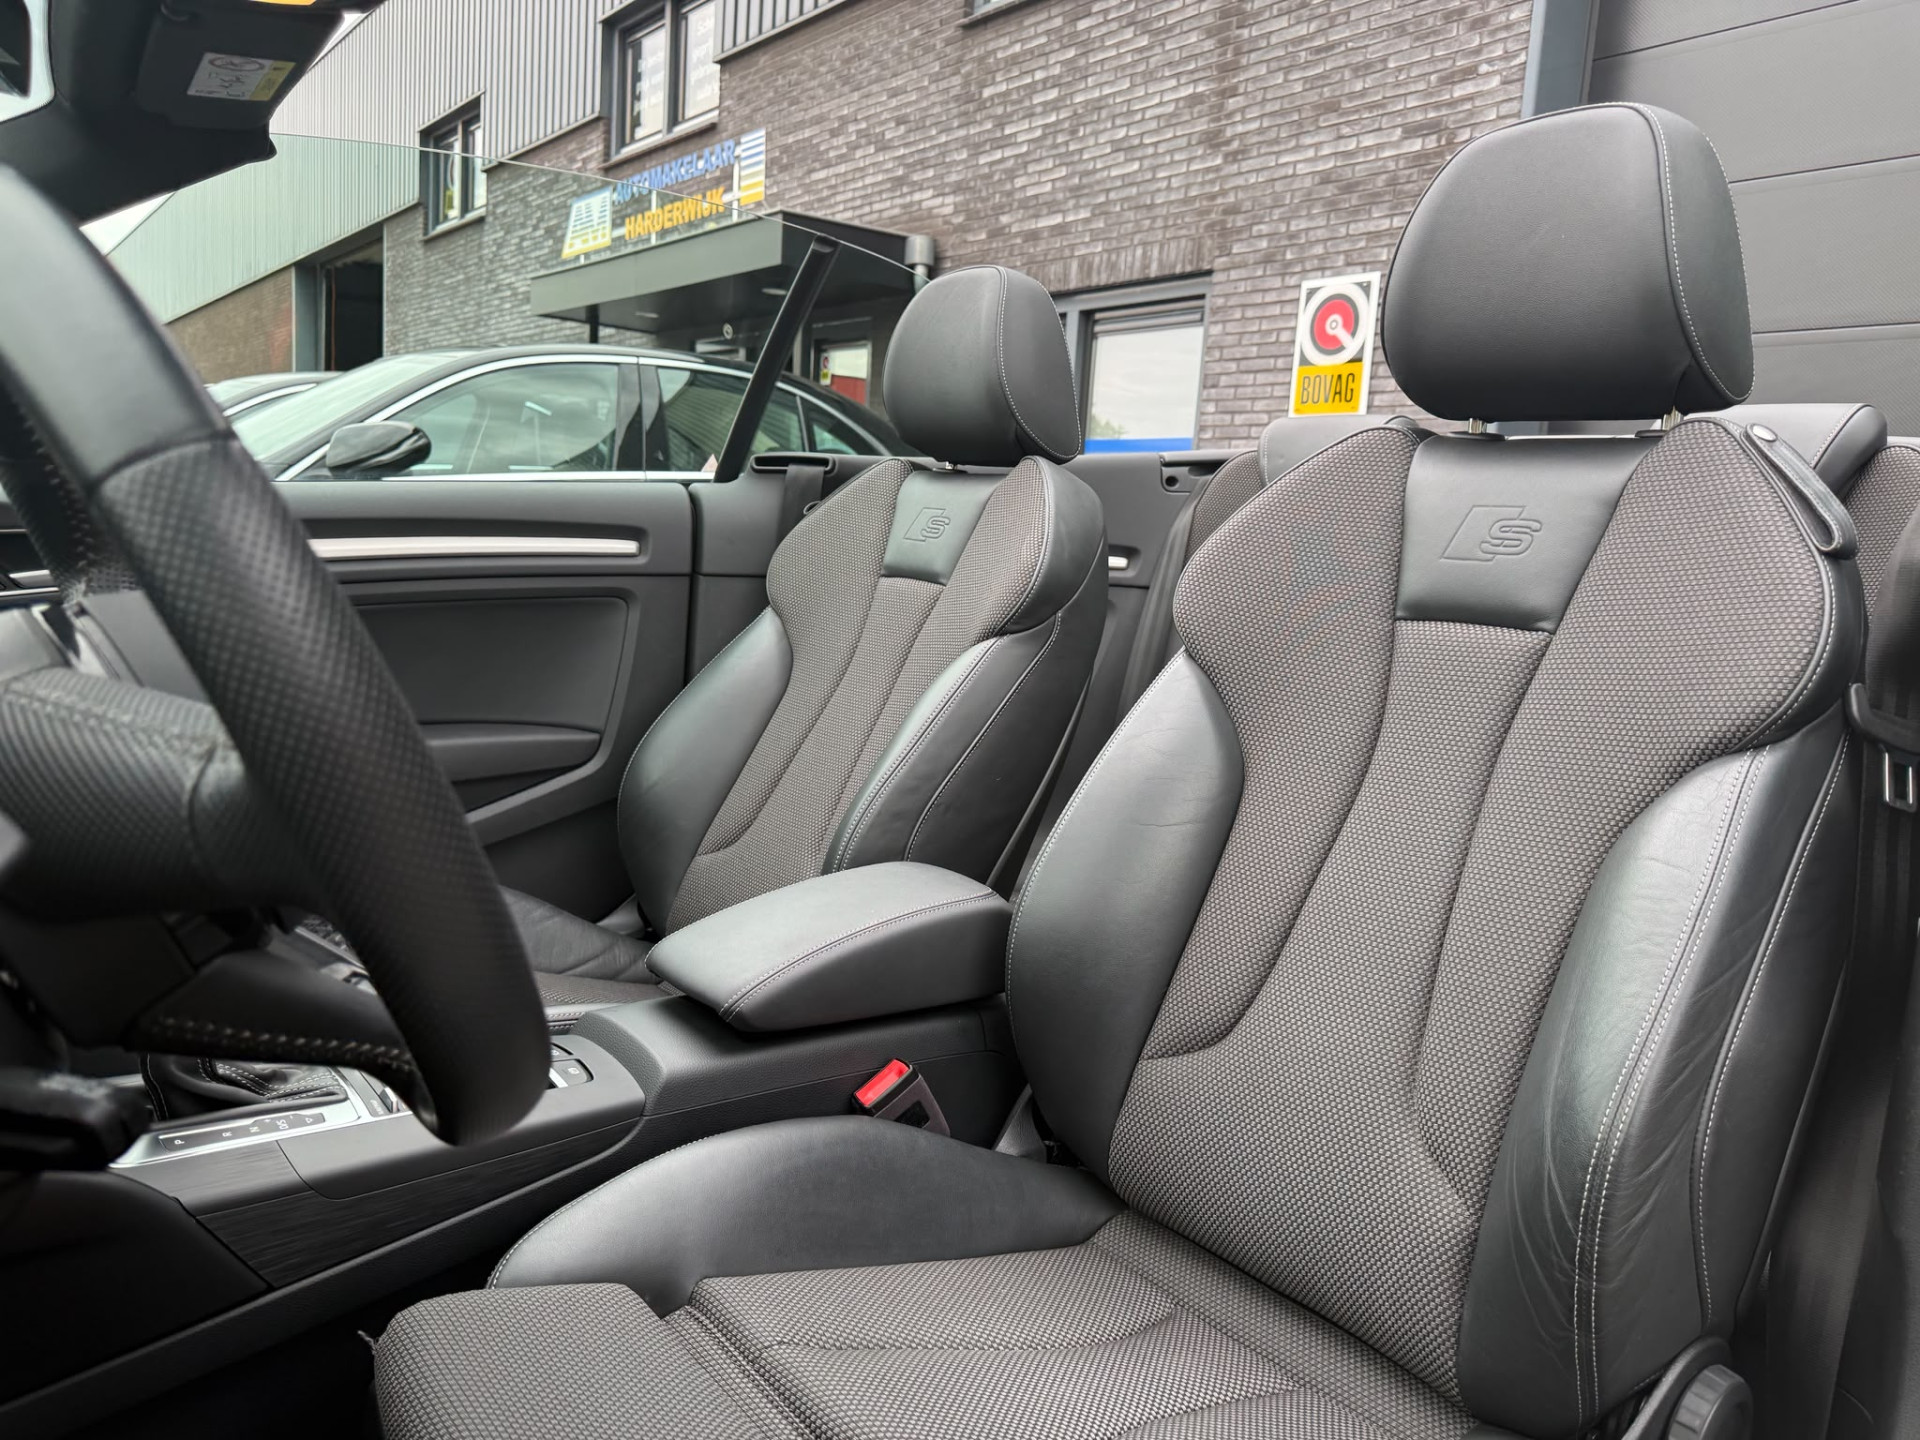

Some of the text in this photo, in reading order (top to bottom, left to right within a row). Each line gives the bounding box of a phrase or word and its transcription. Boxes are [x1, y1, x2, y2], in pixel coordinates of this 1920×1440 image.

[614, 139, 736, 204] AUTOMAKELAAR
[625, 187, 726, 240] HARDERWIJK
[1300, 373, 1355, 404] BOVAG
[920, 515, 951, 540] S
[1480, 518, 1543, 556] S
[174, 1138, 186, 1146] P
